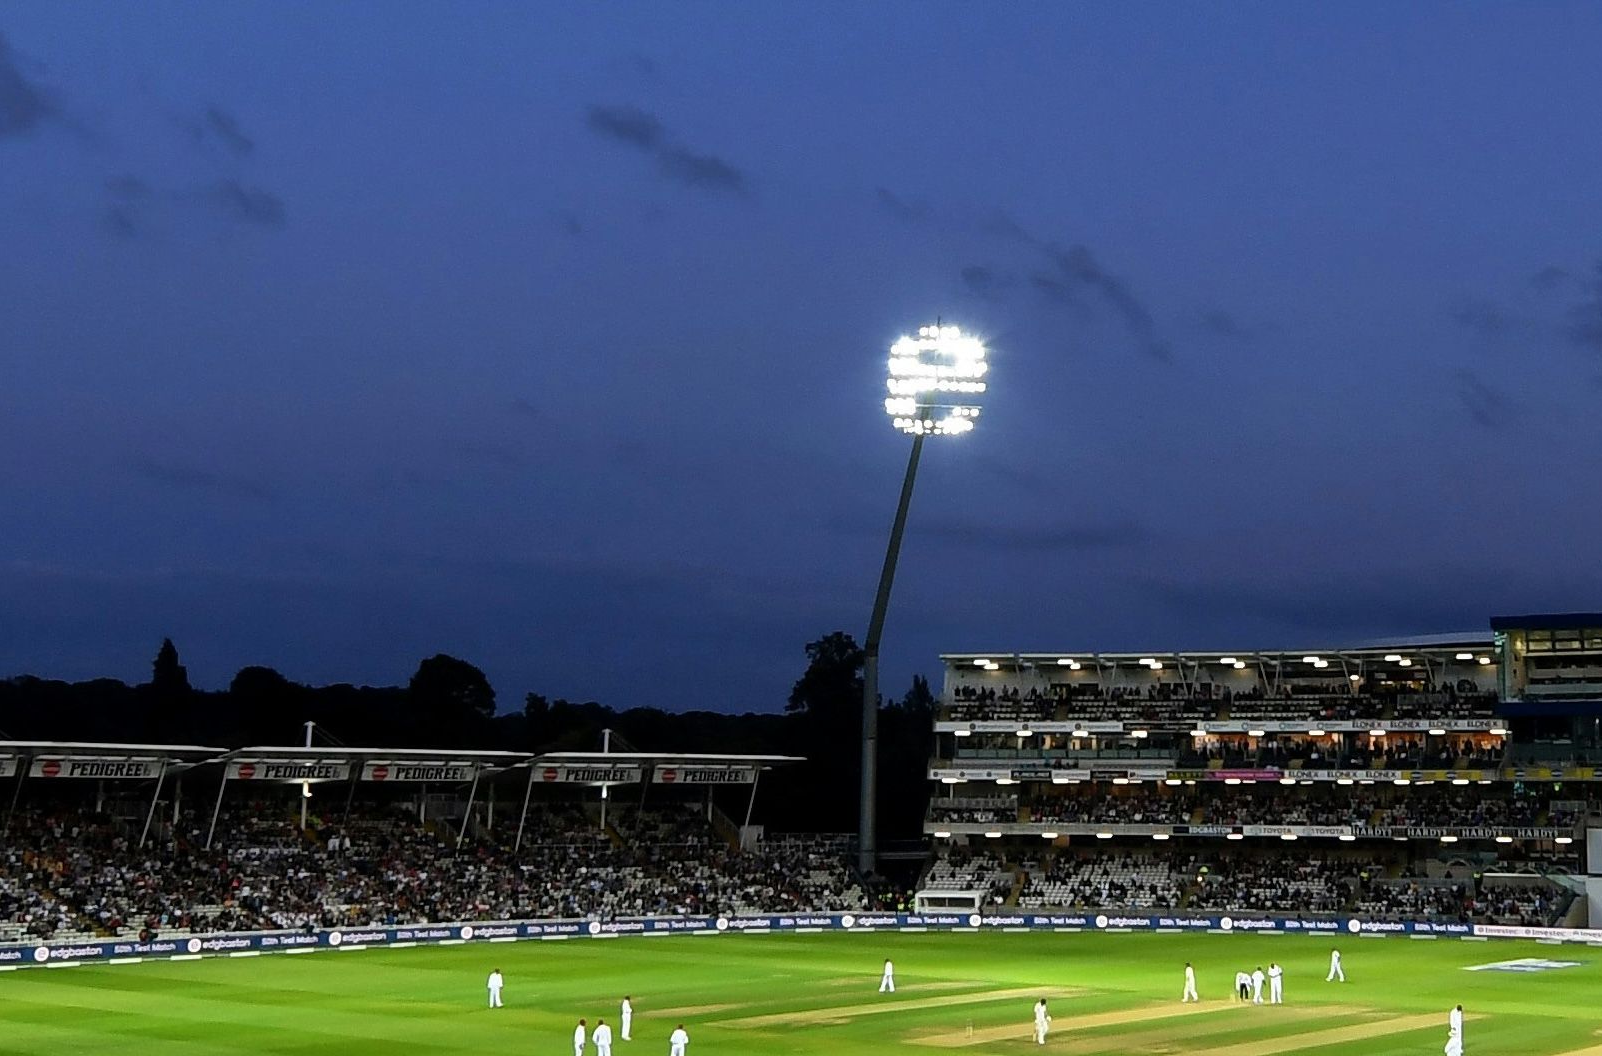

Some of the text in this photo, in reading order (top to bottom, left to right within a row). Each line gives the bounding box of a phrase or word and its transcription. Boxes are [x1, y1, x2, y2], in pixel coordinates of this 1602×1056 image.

[1352, 720, 1381, 728] ELONEX
[1390, 720, 1420, 728] ELONEX
[1428, 720, 1459, 728] ELONEX
[1467, 719, 1497, 728] ELONEX
[69, 761, 143, 776] PEDIGREE
[264, 765, 332, 778] PEDIGREE
[394, 766, 460, 780] PEDIGREE
[565, 770, 626, 782] PEDIGREE
[682, 770, 741, 782] PEDIGREE
[1288, 770, 1319, 778] ELONEX
[1327, 770, 1357, 778] ELONEX
[1365, 770, 1396, 778] ELONEX
[1189, 826, 1233, 835] EDGBASTON
[1263, 827, 1292, 835] TOYOTA
[1315, 827, 1344, 835] TOYOTA
[50, 946, 102, 958] edgbaston
